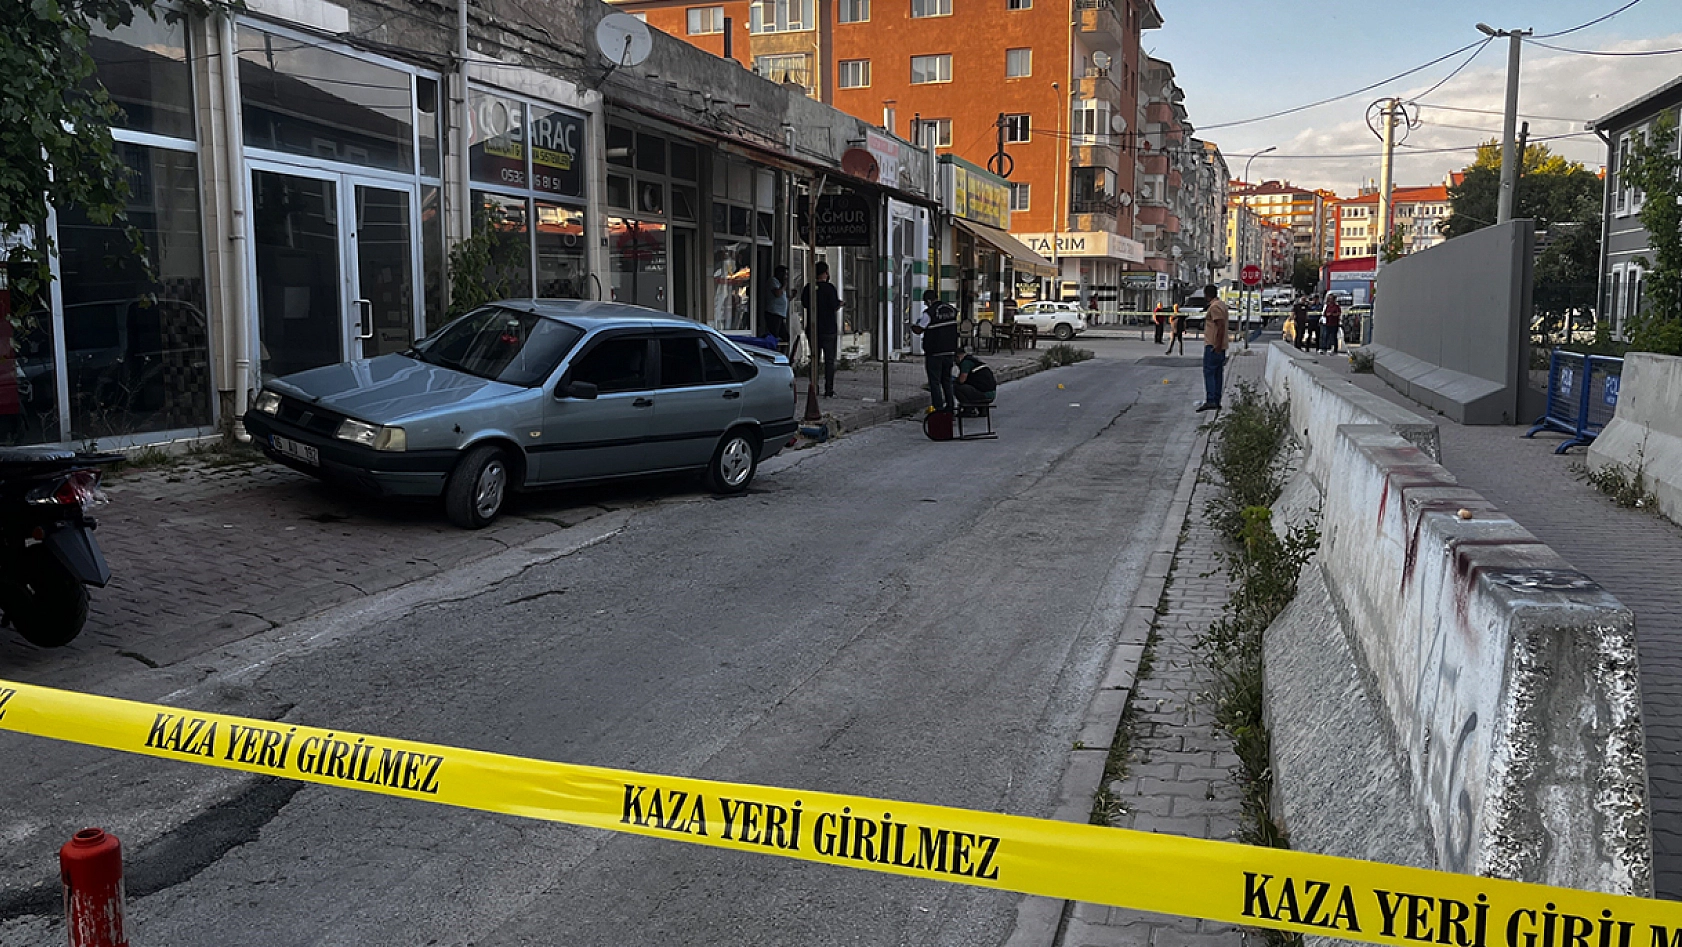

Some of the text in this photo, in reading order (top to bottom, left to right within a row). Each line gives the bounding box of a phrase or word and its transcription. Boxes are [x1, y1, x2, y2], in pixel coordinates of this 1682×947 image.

[1028, 238, 1085, 251] TARIM
[1241, 271, 1260, 280] DUR
[144, 713, 444, 794] KAZA YERİ GİRİLMEZ
[620, 784, 1001, 880] KAZA YERİ GİRİLMEZ
[1242, 871, 1361, 932] KAZA
[1373, 890, 1490, 947] YERİ
